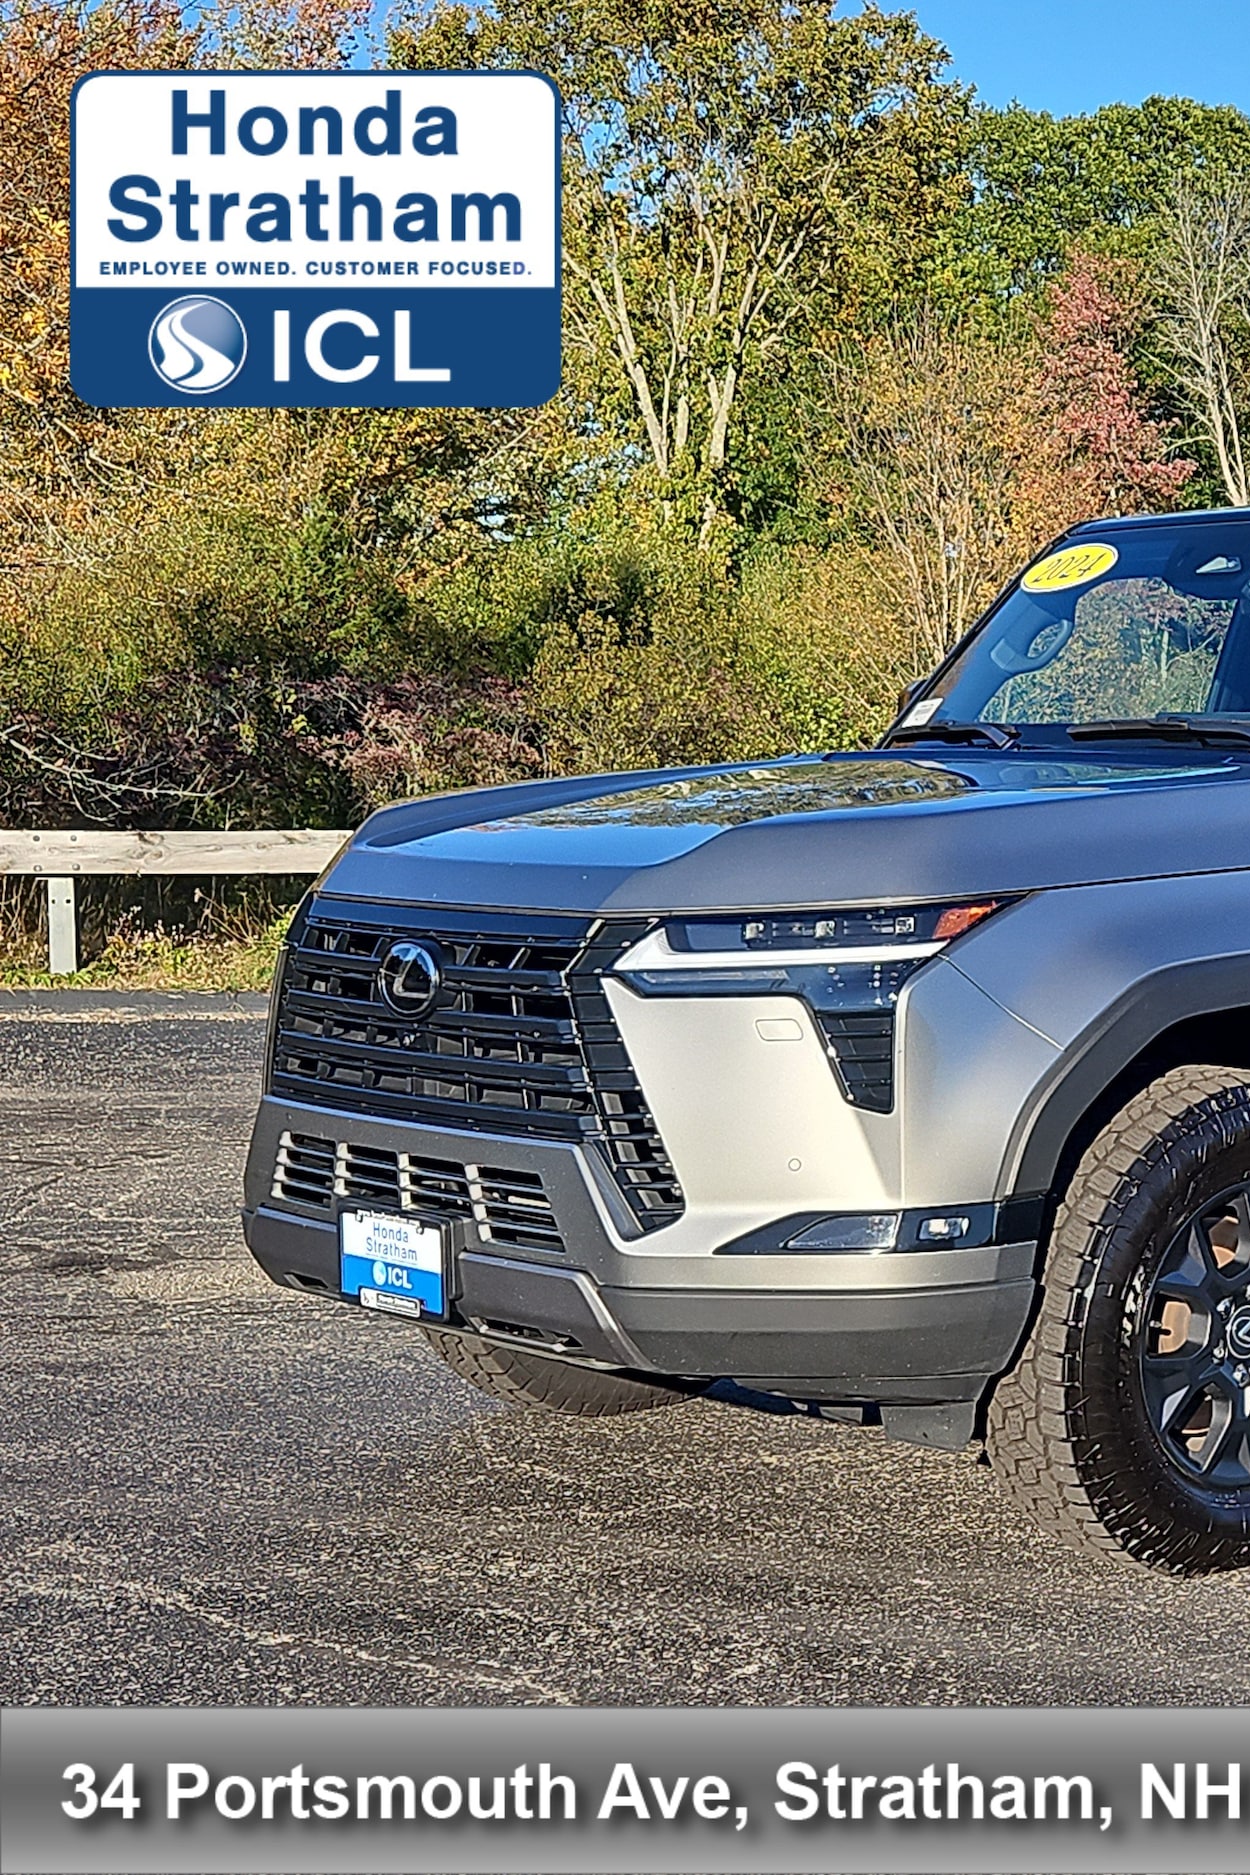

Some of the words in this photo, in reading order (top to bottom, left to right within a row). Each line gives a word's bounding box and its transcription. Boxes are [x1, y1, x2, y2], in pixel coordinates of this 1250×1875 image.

[1031, 551, 1108, 584] 2024
[372, 1221, 410, 1243] Honda
[365, 1236, 419, 1262] Stratham
[387, 1266, 413, 1290] ICL
